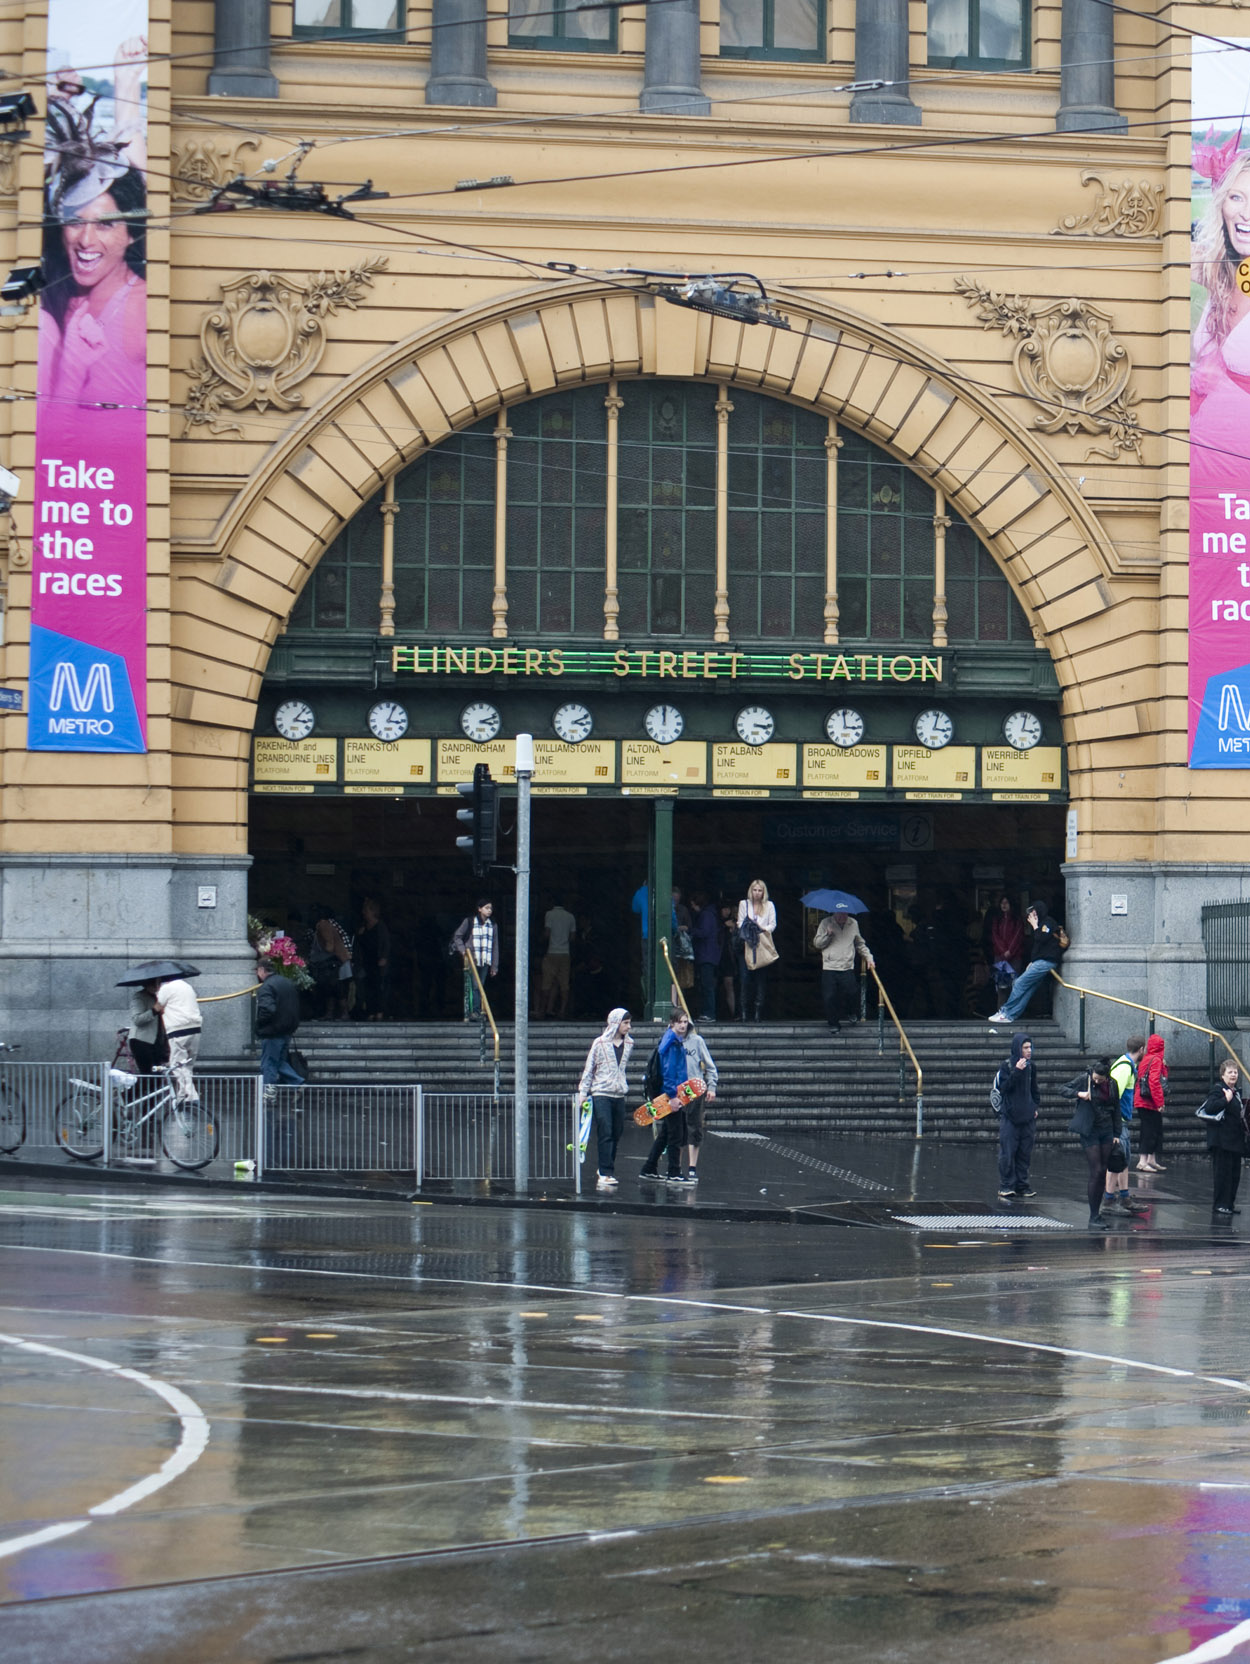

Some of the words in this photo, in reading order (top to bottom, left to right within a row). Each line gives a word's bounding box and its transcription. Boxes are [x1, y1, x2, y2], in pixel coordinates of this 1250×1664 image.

[42, 459, 114, 490] Take
[41, 501, 90, 524] me
[100, 499, 133, 526] to
[40, 530, 94, 560] the
[1202, 532, 1246, 554] me
[40, 572, 122, 596] races
[392, 646, 565, 676] FLINDERS
[613, 649, 744, 678] STREET
[788, 653, 942, 682] STATION
[48, 718, 114, 735] METRO
[256, 742, 299, 750] PAKENHAM
[303, 742, 317, 751] and
[347, 743, 399, 752] FRANKSTON
[442, 744, 506, 752] SANDRINGHAM
[535, 744, 600, 753] WILLIAMSTOWN
[627, 745, 660, 754] ALTONA
[717, 746, 728, 755] ST
[730, 747, 763, 756] ALBANS
[808, 748, 880, 758] BROADMEADOWS
[898, 750, 932, 759] UPFIELD
[987, 751, 1029, 760] WERRIBEE
[256, 753, 311, 763] CRANBOURNE
[313, 754, 335, 764] LINES
[347, 754, 366, 764] LINE
[442, 756, 461, 765] LINE
[535, 756, 553, 765] LINE
[626, 757, 645, 766] LINE
[717, 759, 735, 767] LINE
[808, 760, 826, 769] LINE
[897, 762, 916, 770] LINE
[986, 762, 1004, 771] LINE
[776, 823, 841, 837] Customer
[847, 822, 897, 837] Service
